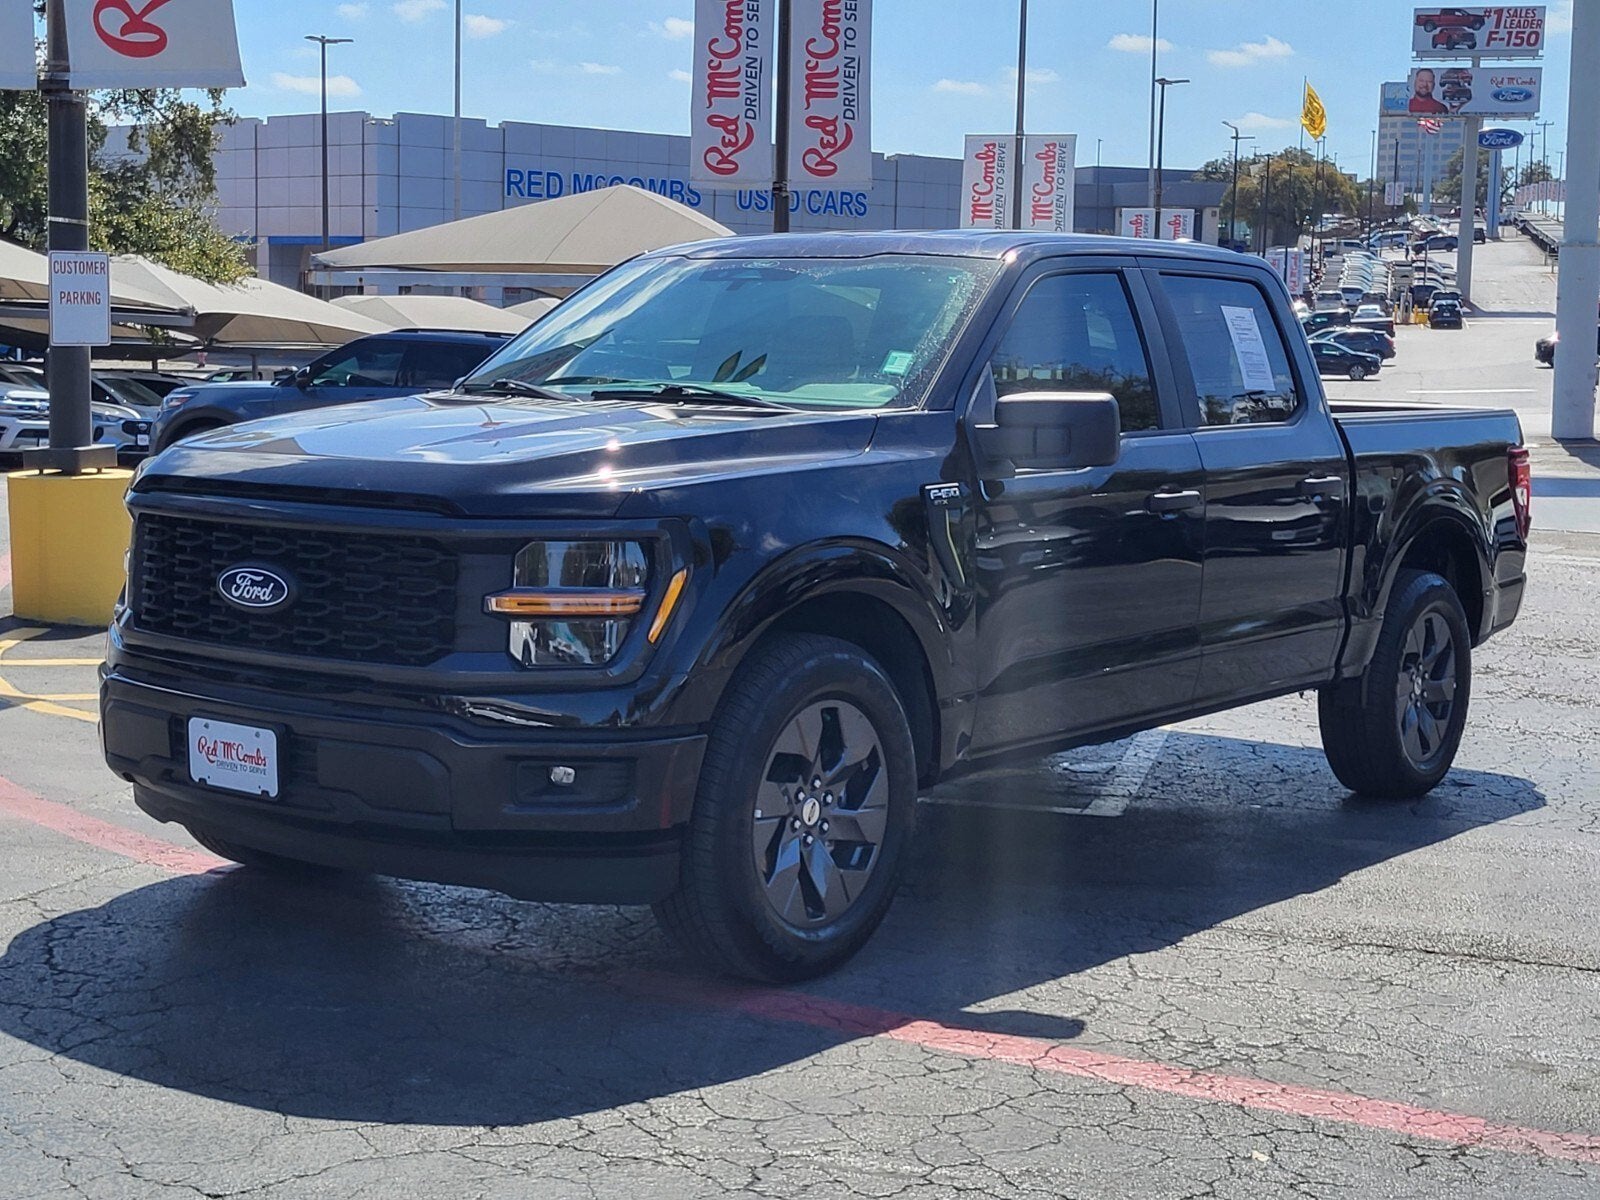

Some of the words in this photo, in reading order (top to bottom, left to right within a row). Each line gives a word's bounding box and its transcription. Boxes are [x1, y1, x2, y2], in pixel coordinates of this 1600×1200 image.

[747, 0, 760, 22] SE
[845, 0, 858, 22] SE
[1483, 8, 1503, 29] #1
[1506, 8, 1536, 18] SALES
[1504, 19, 1543, 29] LEADER
[746, 27, 759, 50] TO
[844, 27, 857, 50] TO
[1485, 31, 1540, 47] F-150
[706, 0, 744, 109] McCom
[805, 0, 842, 110] McCom
[745, 56, 758, 120] DRIVEN
[843, 56, 856, 121] DRIVEN
[1499, 90, 1525, 100] Ford
[704, 114, 755, 175] Red
[802, 115, 853, 177] Red
[1482, 132, 1513, 145] Ford
[997, 142, 1006, 174] SERVE
[1057, 142, 1067, 174] SERVE
[506, 169, 564, 198] RED
[971, 143, 996, 226] McCombs
[996, 177, 1004, 190] TO
[1031, 142, 1057, 227] McCombs
[1056, 177, 1065, 190] TO
[738, 190, 799, 212] USD
[808, 190, 867, 217] CARS
[53, 260, 106, 275] CUSTOMER
[60, 291, 101, 304] PARKING
[231, 572, 274, 601] Ford
[198, 736, 218, 763] Red
[220, 741, 266, 767] McCombs
[216, 760, 238, 770] DRIVEN
[240, 764, 247, 772] TO
[249, 765, 266, 776] SERVE
